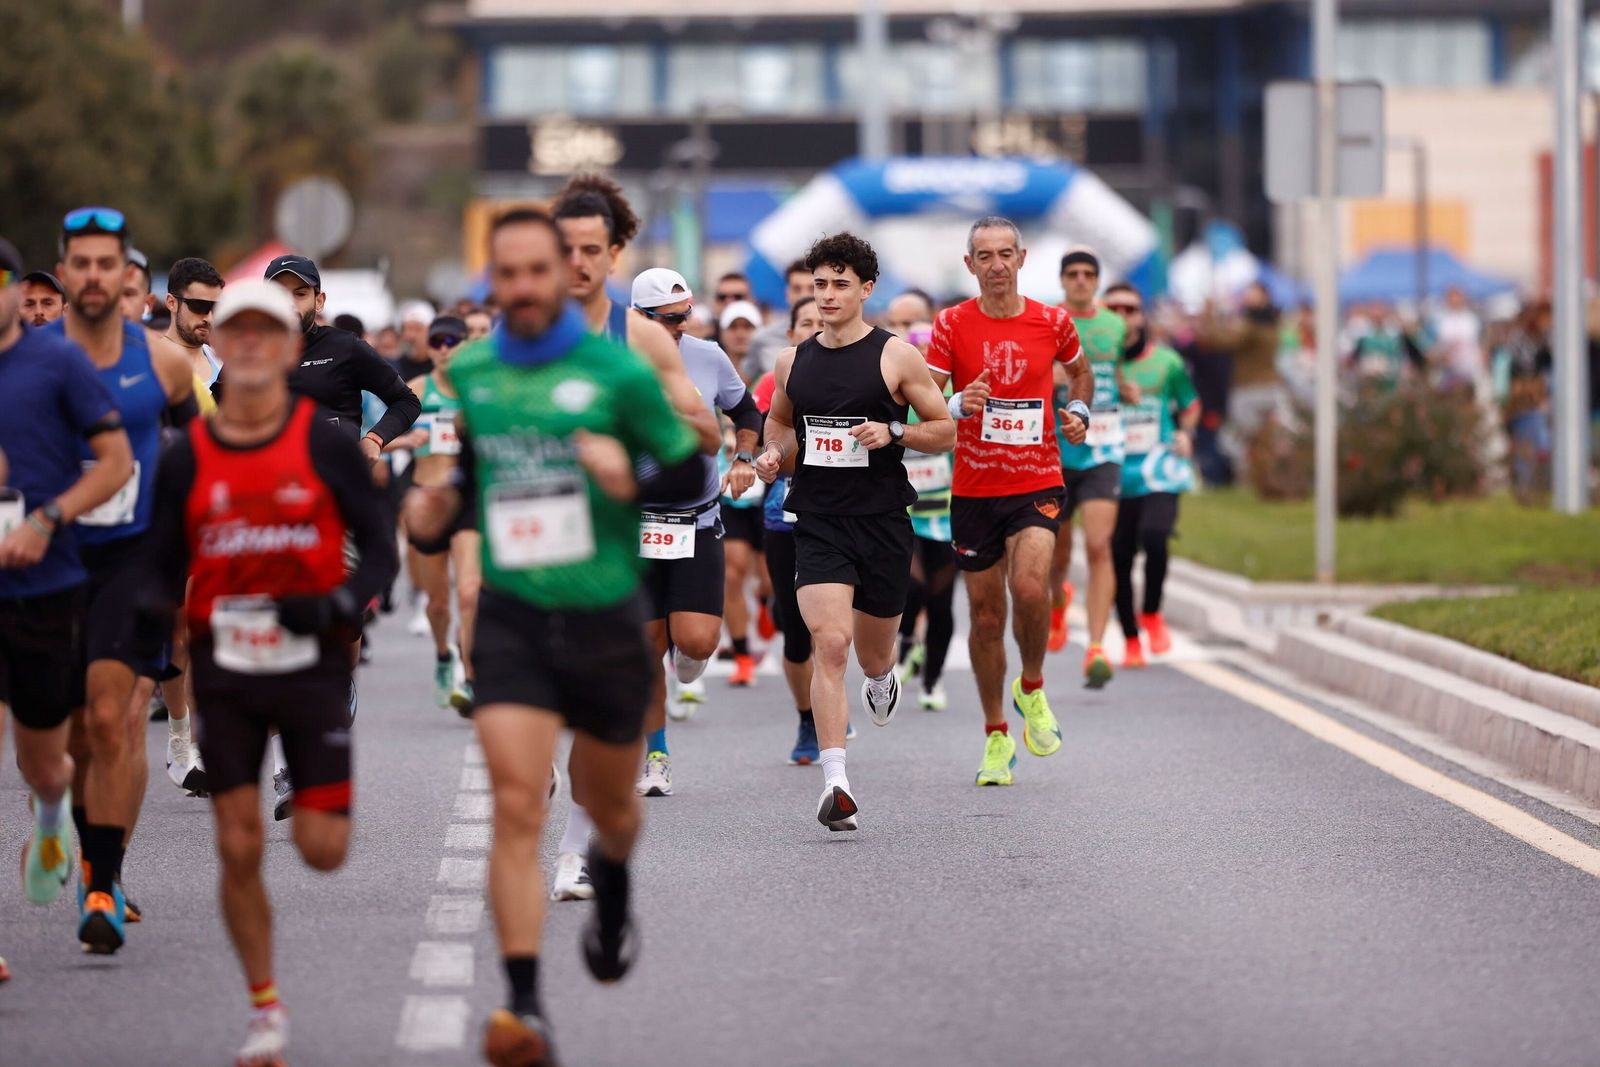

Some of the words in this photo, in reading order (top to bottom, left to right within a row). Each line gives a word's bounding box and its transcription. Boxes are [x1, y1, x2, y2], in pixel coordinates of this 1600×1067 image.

[991, 417, 1024, 431] 364
[815, 437, 843, 452] 718
[642, 532, 674, 546] 239
